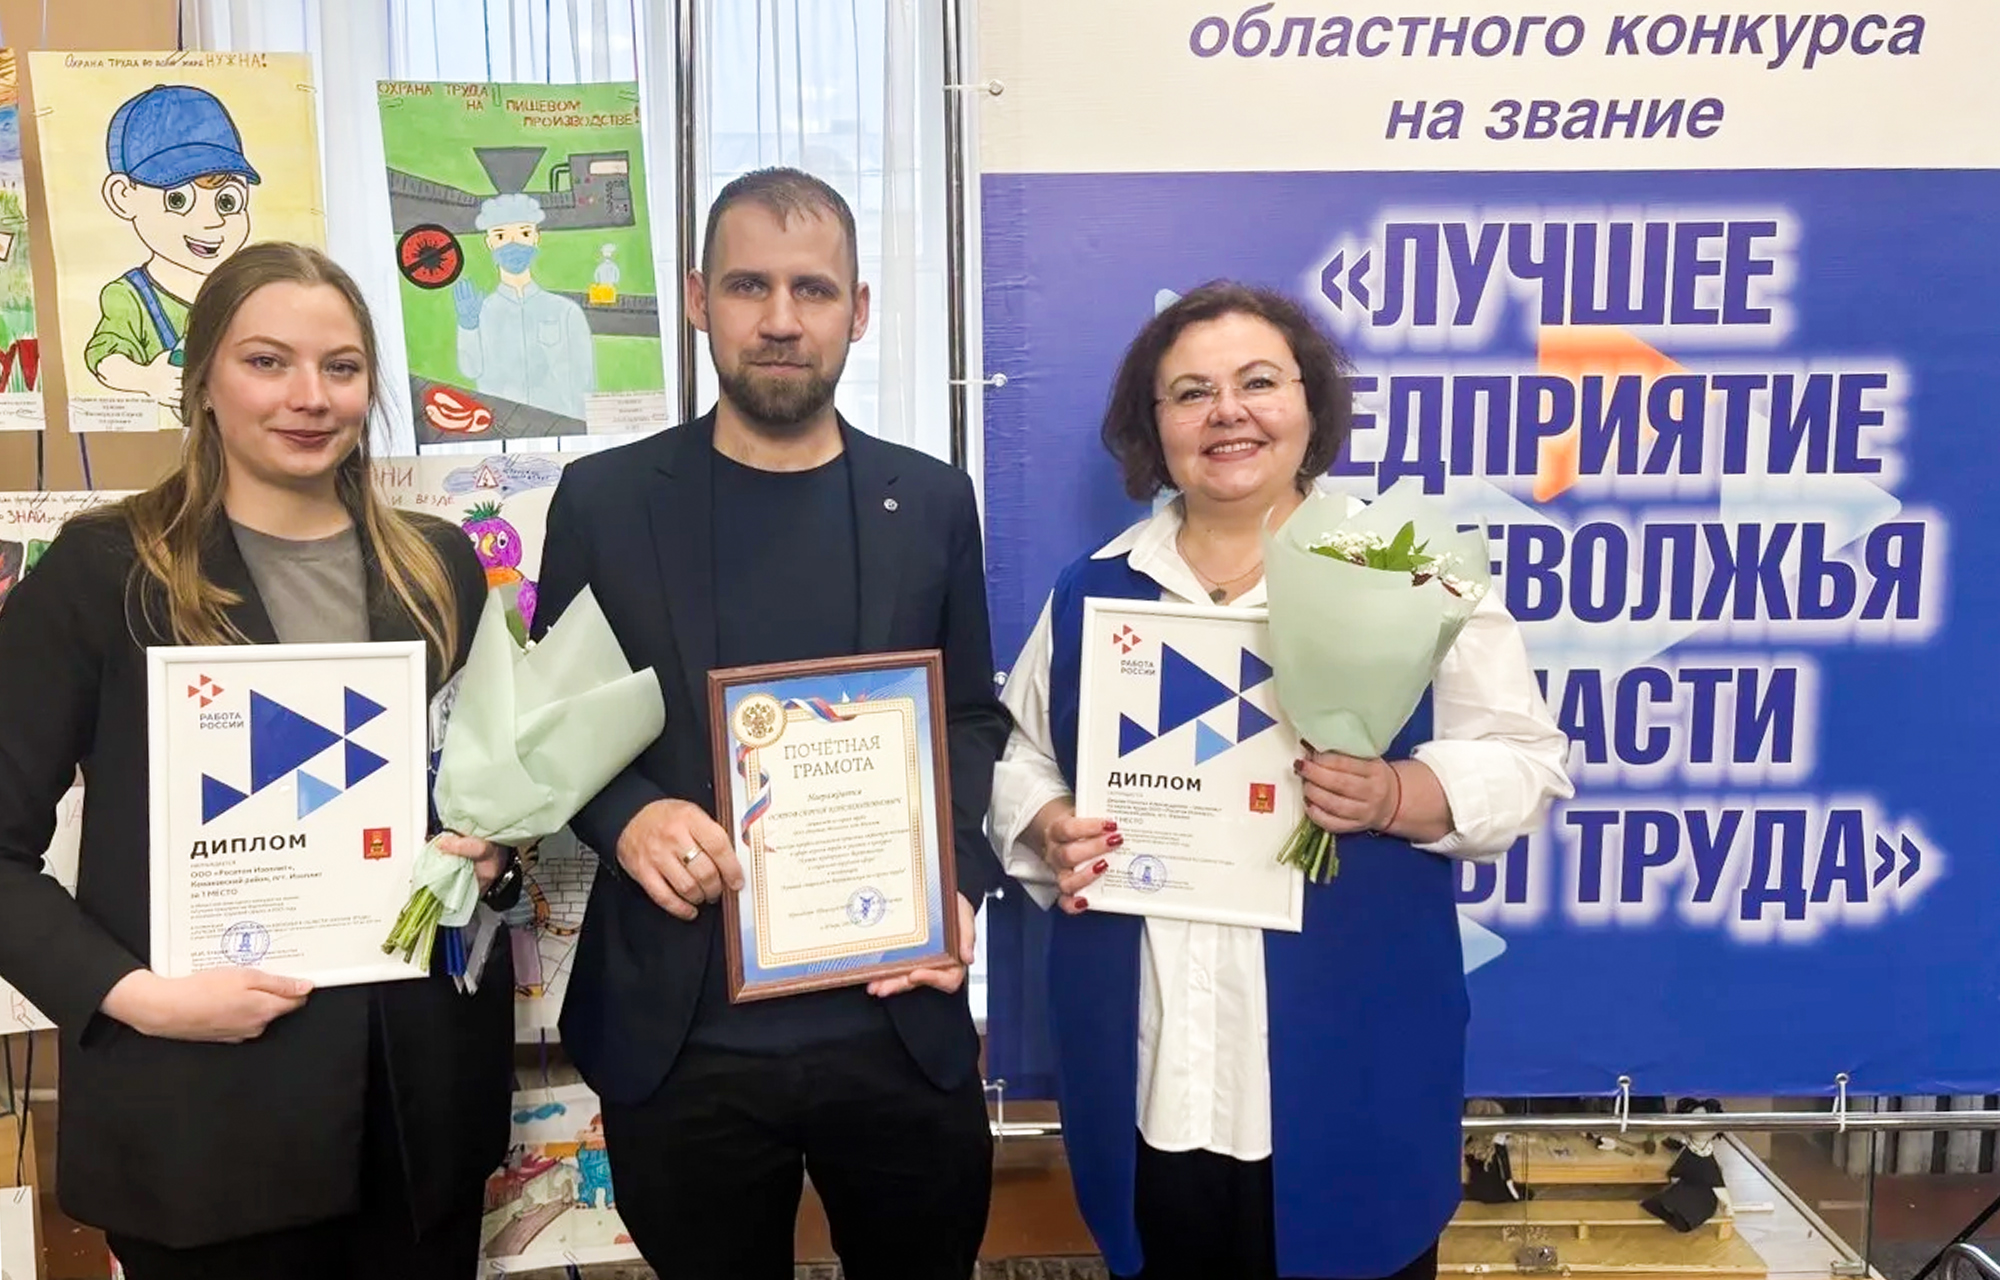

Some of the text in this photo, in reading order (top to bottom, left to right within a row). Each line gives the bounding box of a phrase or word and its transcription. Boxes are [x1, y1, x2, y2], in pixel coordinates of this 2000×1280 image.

[1190, 2, 1926, 69] областного конкурса
[378, 83, 488, 97] ОХРАНА ТРУДА
[466, 99, 581, 113] НА ПИЩЕВОМ
[1385, 97, 1724, 139] на звание
[1321, 221, 1777, 327] «ЛУЧШЕЕ
[1330, 373, 1888, 496] ЕДПРИЯТИЕ
[1457, 521, 1926, 624] ВОЛЖЬЯ
[1121, 660, 1154, 668] РАБОТА
[1121, 667, 1155, 675] РОССИИ
[200, 711, 242, 720] РАБОТА
[200, 721, 244, 729] РОССИИ
[1534, 666, 1797, 766] АСТИ
[793, 757, 874, 779] ГРАМОТА
[1108, 771, 1201, 791] ДИПЛОМ
[190, 833, 306, 859] ДИПЛОМ
[1566, 810, 1921, 920] ТРУДА»
